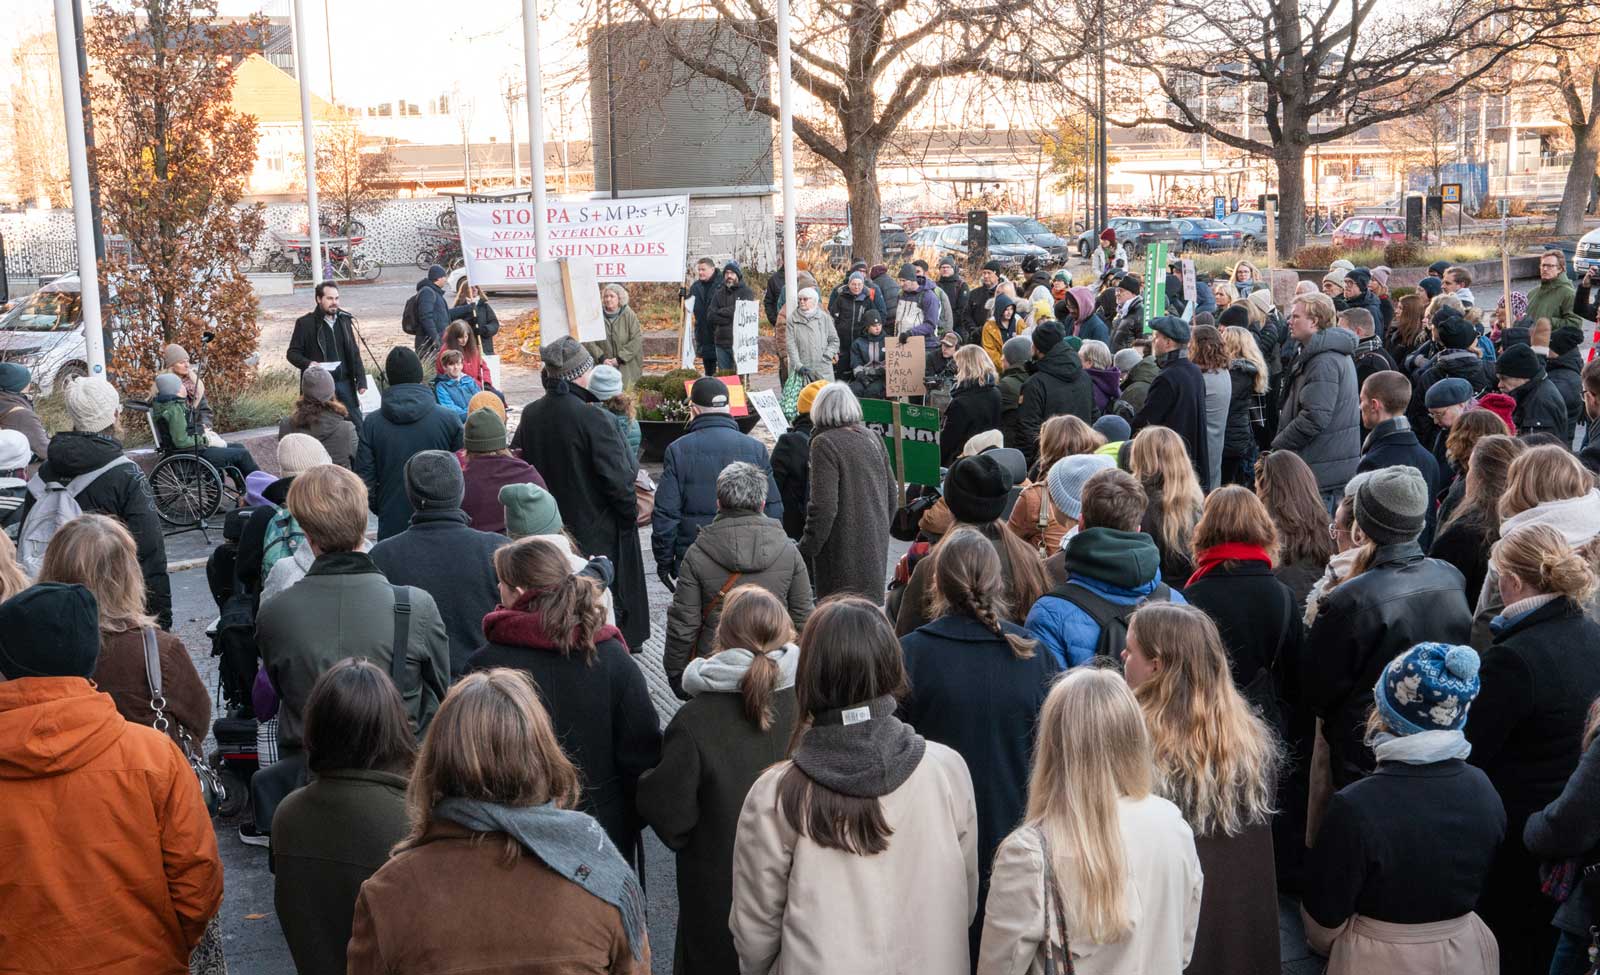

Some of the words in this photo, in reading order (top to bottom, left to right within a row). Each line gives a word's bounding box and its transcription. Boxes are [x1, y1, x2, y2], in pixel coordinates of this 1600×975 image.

[492, 208, 570, 225] STOPA
[493, 225, 618, 240] NEDMNTERING
[624, 224, 645, 237] AV
[505, 262, 627, 278] RÄTTER
[888, 351, 912, 359] BARA
[888, 368, 913, 378] VARA
[889, 384, 919, 393] SJÄLV
